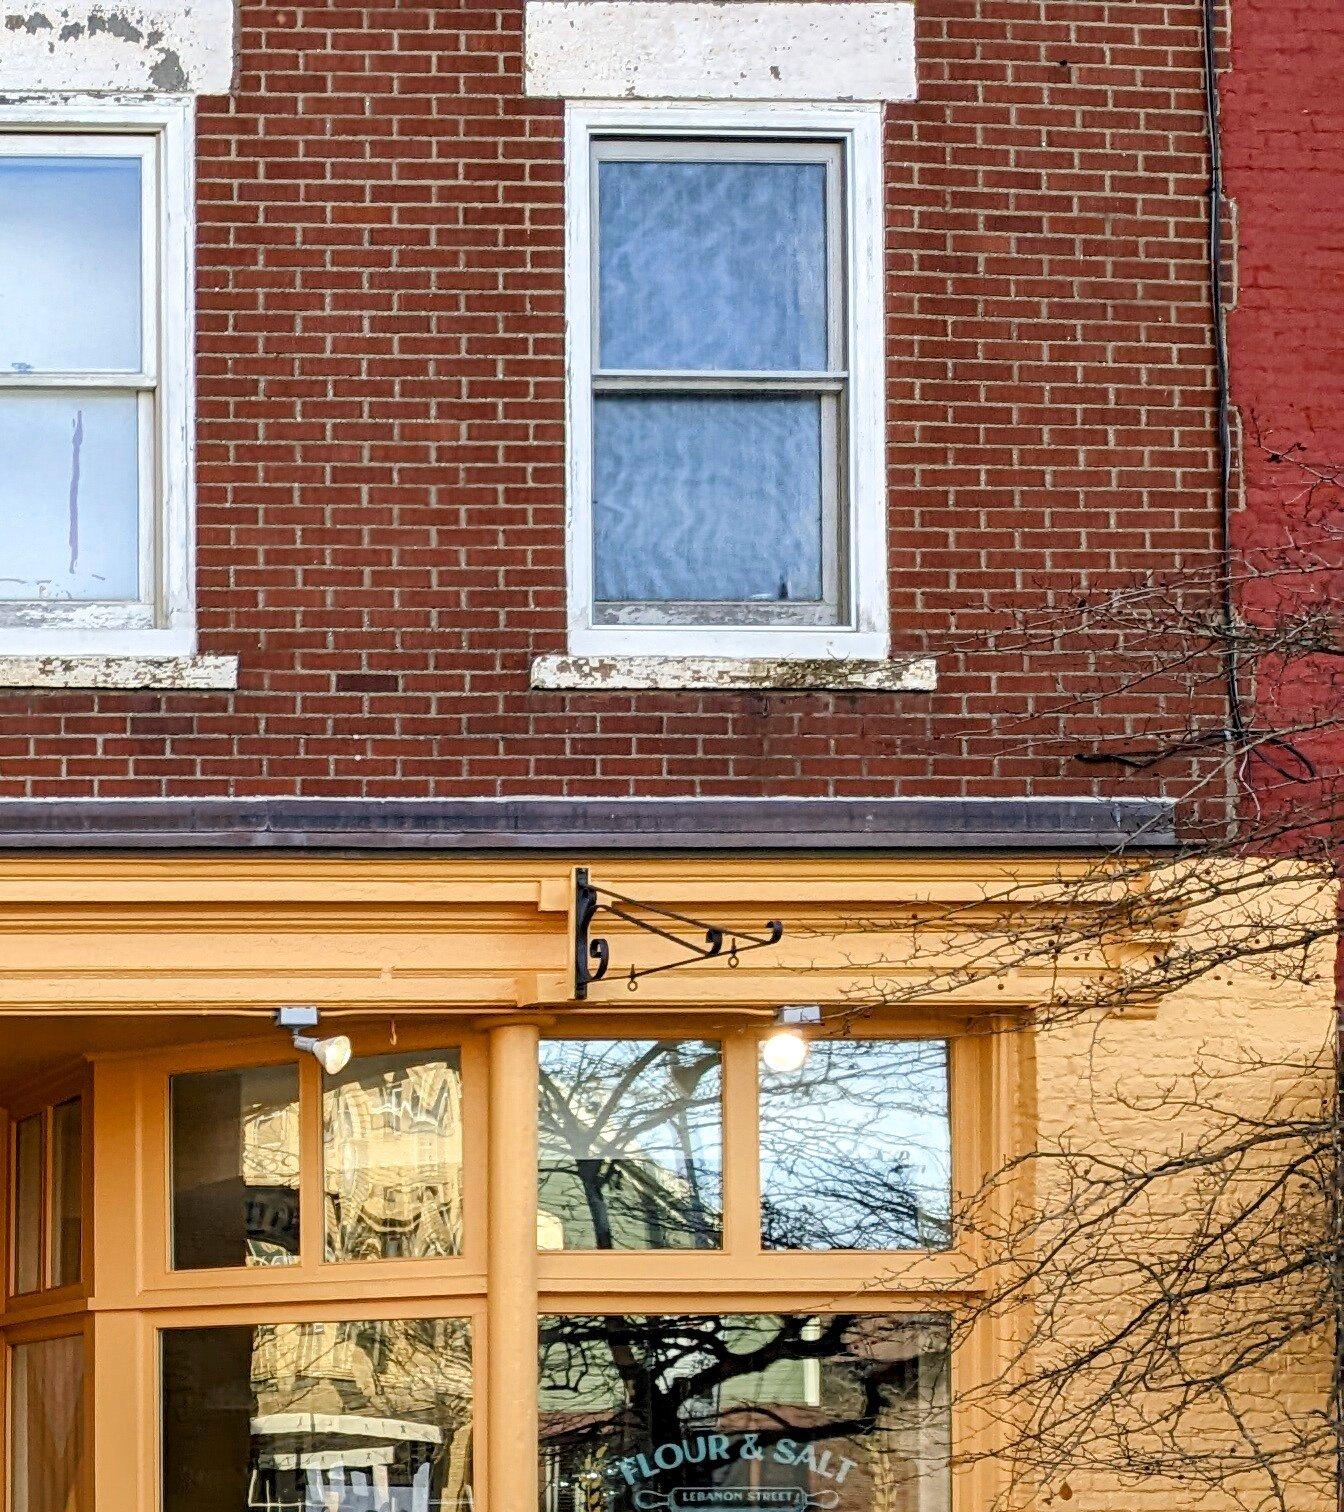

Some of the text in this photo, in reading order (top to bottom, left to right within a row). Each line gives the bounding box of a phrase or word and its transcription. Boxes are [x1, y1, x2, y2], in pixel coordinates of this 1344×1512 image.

[615, 1433, 858, 1485] FLOUR & SALT
[682, 1491, 743, 1502] LEBANON
